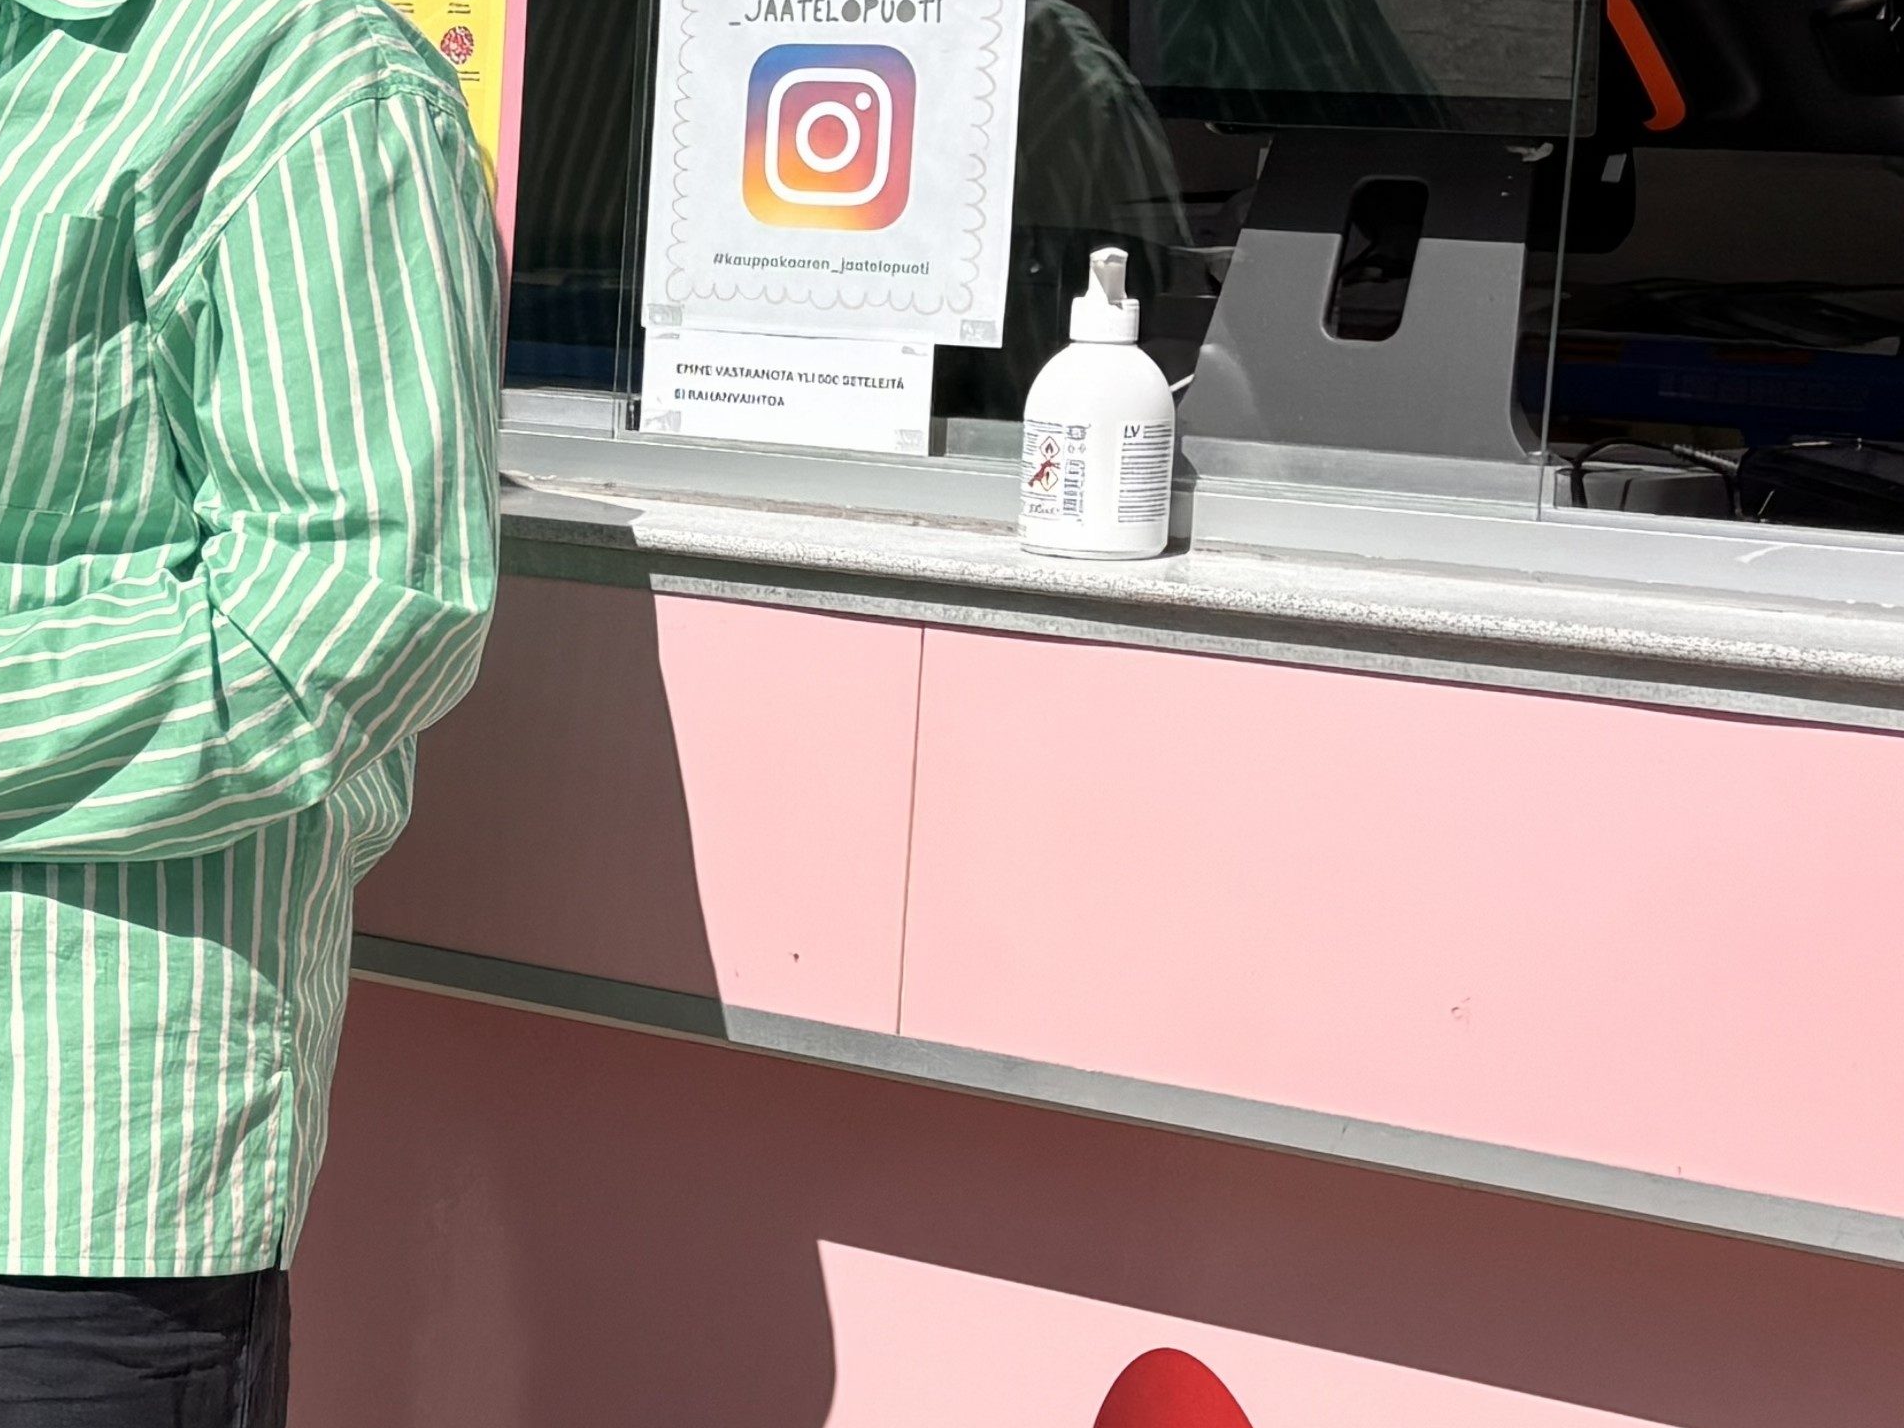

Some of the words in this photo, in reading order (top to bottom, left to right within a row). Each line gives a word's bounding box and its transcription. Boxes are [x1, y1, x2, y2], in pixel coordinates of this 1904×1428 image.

[676, 363, 713, 376] EMME
[715, 366, 794, 382] VASTAANOTA
[797, 372, 815, 384] YLI
[842, 375, 905, 390] SETELEITÄ
[1123, 424, 1141, 439] LV
